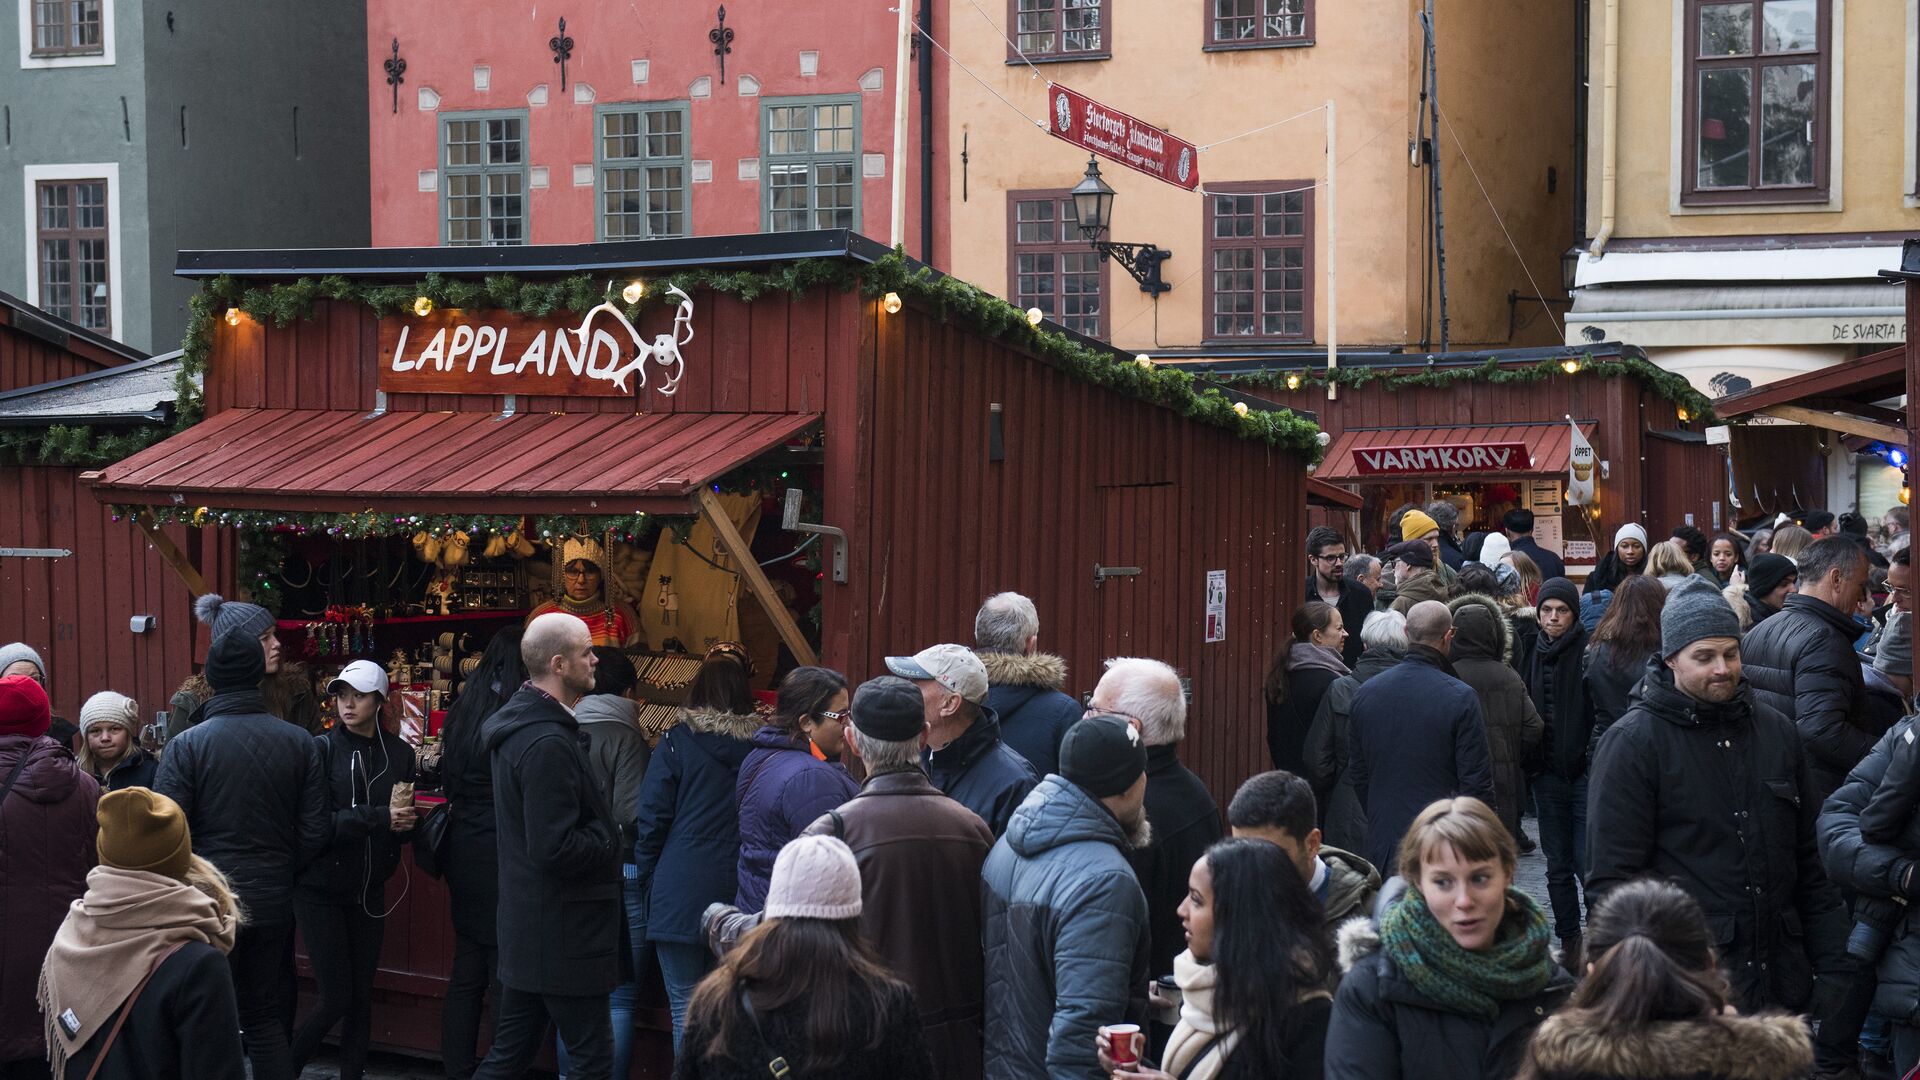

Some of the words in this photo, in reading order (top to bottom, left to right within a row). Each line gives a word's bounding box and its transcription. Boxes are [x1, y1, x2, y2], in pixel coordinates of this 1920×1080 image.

[1085, 103, 1126, 139] Stortorgets
[1832, 323, 1849, 340] DE
[1852, 323, 1896, 340] SVARTA
[392, 325, 620, 380] LAPPLAND
[1361, 446, 1511, 471] VARMKORV
[1574, 445, 1592, 457] ÖPPET
